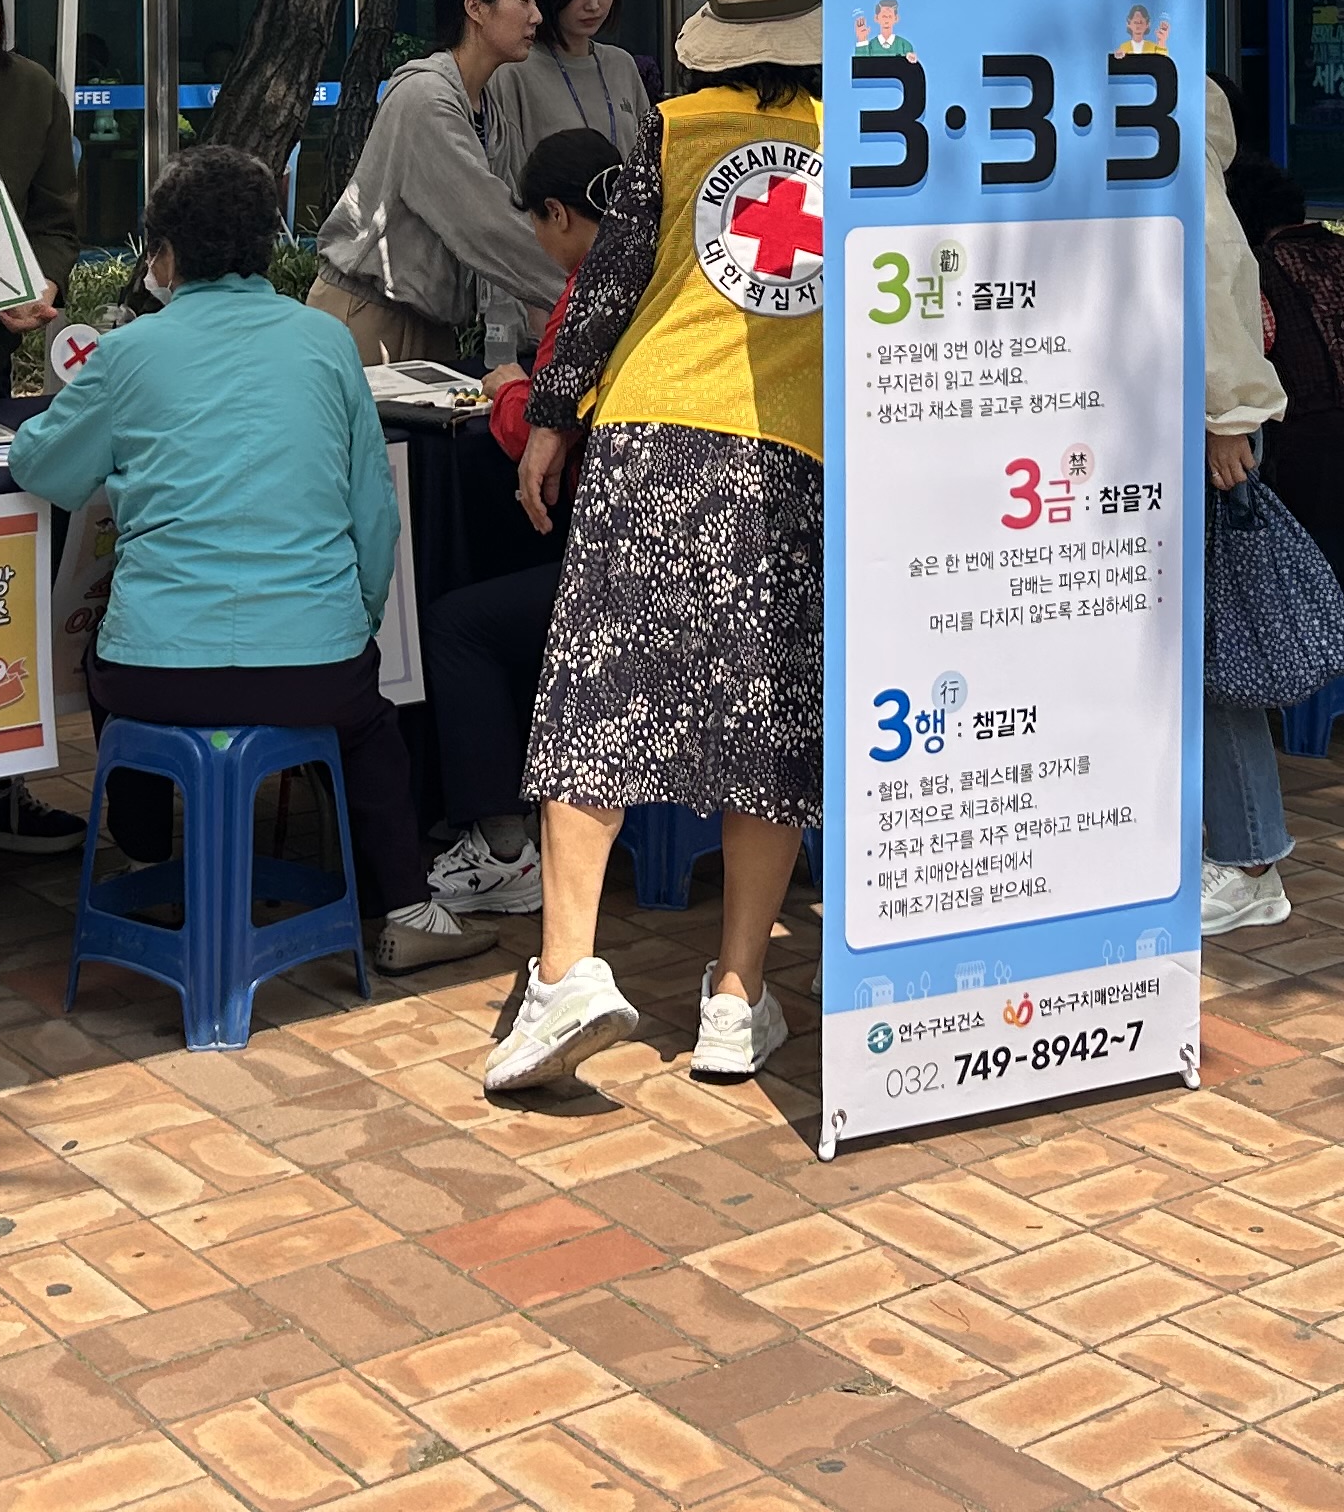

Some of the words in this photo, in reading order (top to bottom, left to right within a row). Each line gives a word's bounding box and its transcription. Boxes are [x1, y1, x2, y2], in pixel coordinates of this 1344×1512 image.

[75, 91, 111, 105] FFEE
[702, 145, 778, 207] KOREAN
[783, 146, 823, 178] RED
[703, 238, 823, 311] 대한적십자
[868, 252, 945, 324] 3권
[972, 280, 1037, 311] 즐길것
[877, 342, 938, 365] 일주일에
[943, 340, 968, 361] 3번
[974, 338, 1003, 358] 이상
[1009, 335, 1071, 356] 걸으세요.
[877, 372, 938, 394] 부지런히
[944, 370, 973, 390] 읽고
[979, 367, 1028, 387] 쓰세요.
[877, 402, 923, 424] 생선과
[928, 398, 973, 420] 채소를
[979, 395, 1024, 417] 골고루
[1029, 391, 1105, 412] 챙겨드세요.
[1068, 452, 1087, 476] 禁
[1001, 458, 1076, 529] 3금
[1099, 482, 1163, 514] 참을것
[908, 554, 939, 578] 술은
[945, 553, 959, 573] 한
[965, 551, 994, 572] 번에
[999, 546, 1053, 568] 3잔보다
[1058, 542, 1087, 564] 적게
[1091, 537, 1152, 558] 마시세요.
[1009, 574, 1053, 597] 담배는
[1058, 570, 1101, 591] 피우지
[1106, 565, 1152, 586] 마세요.
[929, 611, 974, 633] 머리를
[980, 606, 1024, 630] 다치지
[1029, 601, 1072, 624] 않도록
[1077, 594, 1152, 618] 조심하세요.
[940, 680, 960, 705] 行
[868, 688, 946, 762] 3행
[972, 705, 1038, 740] 챙길것
[878, 780, 913, 802] 혈압,
[919, 776, 953, 797] 혈당,
[960, 762, 1034, 789] 콜레스테롤
[1038, 755, 1091, 779] 3가지를
[878, 803, 954, 832] 정기적으로
[960, 792, 1038, 819] 체크하세요.
[878, 838, 924, 861] 가족과
[930, 830, 974, 855] 친구를
[979, 825, 1009, 847] 자주
[1014, 816, 1071, 842] 연락하고
[1077, 806, 1137, 831] 만나세요.
[878, 868, 908, 892] 매년
[914, 849, 1033, 885] 치매안심센터에서
[878, 887, 984, 921] 치매조기검진을
[989, 876, 1051, 903] 받으세요.
[899, 1010, 985, 1043] 연수구보건소
[1039, 977, 1160, 1017] 연수구치매안심센터
[886, 1062, 946, 1099] 032.
[955, 1020, 1144, 1086] 749-8942~7
